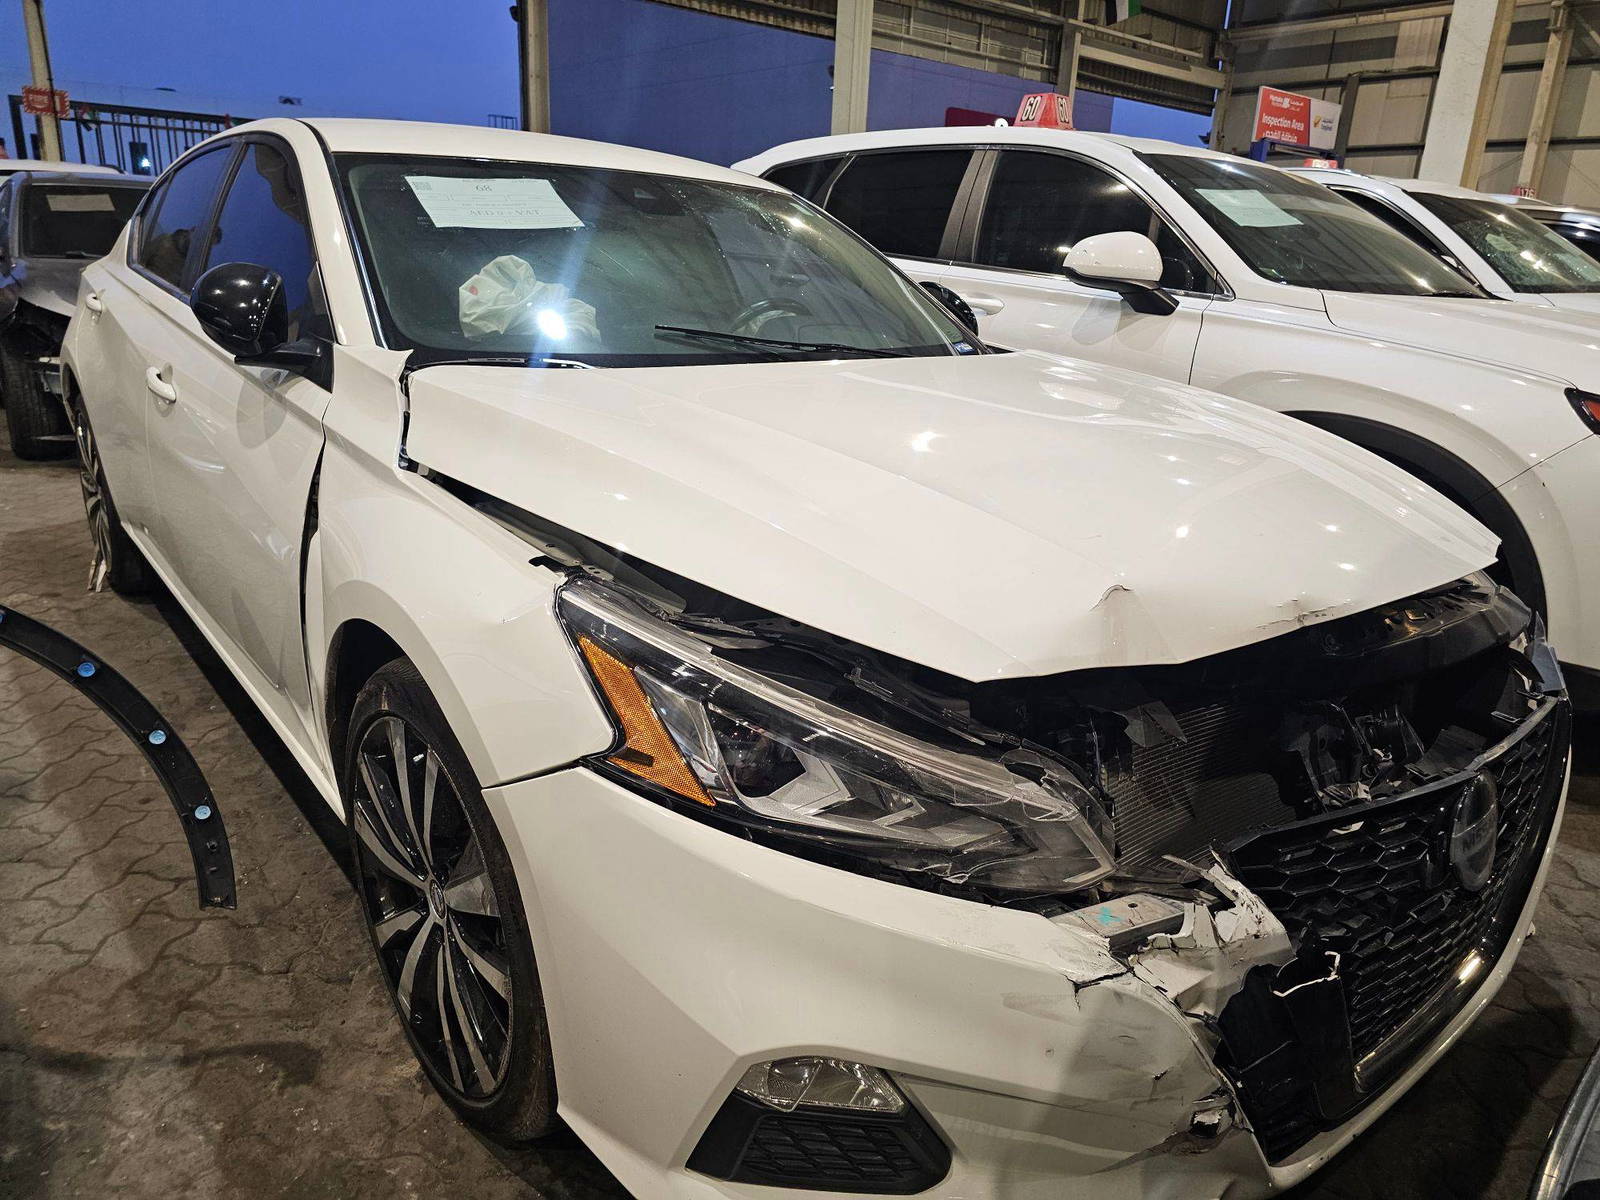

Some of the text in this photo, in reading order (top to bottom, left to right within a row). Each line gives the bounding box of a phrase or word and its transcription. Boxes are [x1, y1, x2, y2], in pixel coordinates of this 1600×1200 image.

[1021, 96, 1042, 121] 60
[1058, 98, 1069, 123] 60
[1262, 113, 1304, 131] Inspection Area
